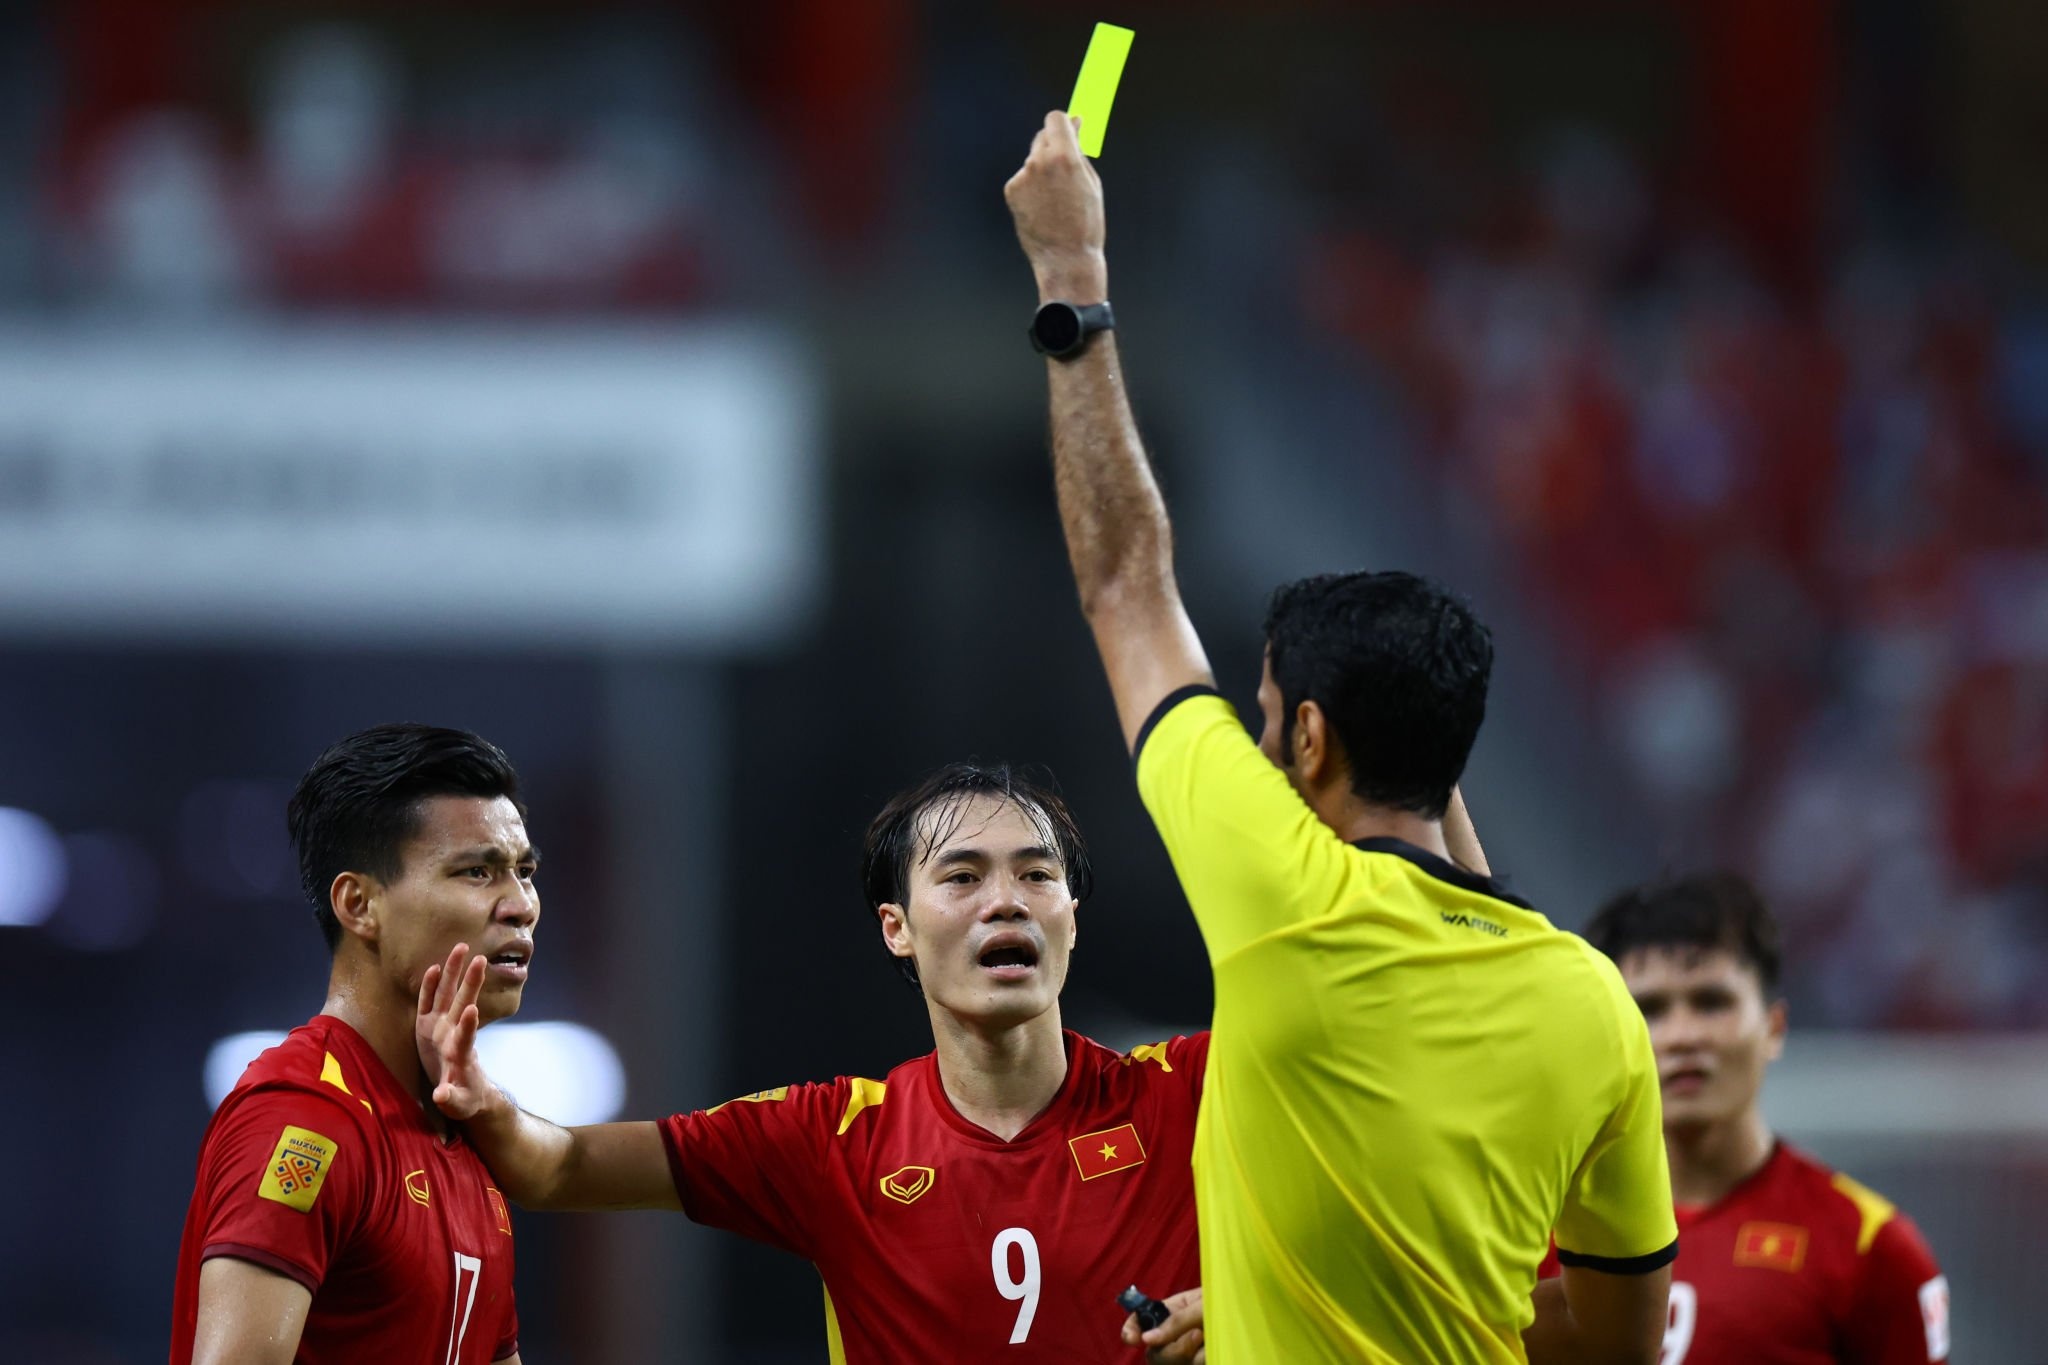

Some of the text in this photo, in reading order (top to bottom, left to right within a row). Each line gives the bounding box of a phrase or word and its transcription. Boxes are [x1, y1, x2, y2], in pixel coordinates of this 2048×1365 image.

[289, 1138, 326, 1156] SUZUKI
[445, 1251, 482, 1365] 17
[991, 1227, 1041, 1345] 9
